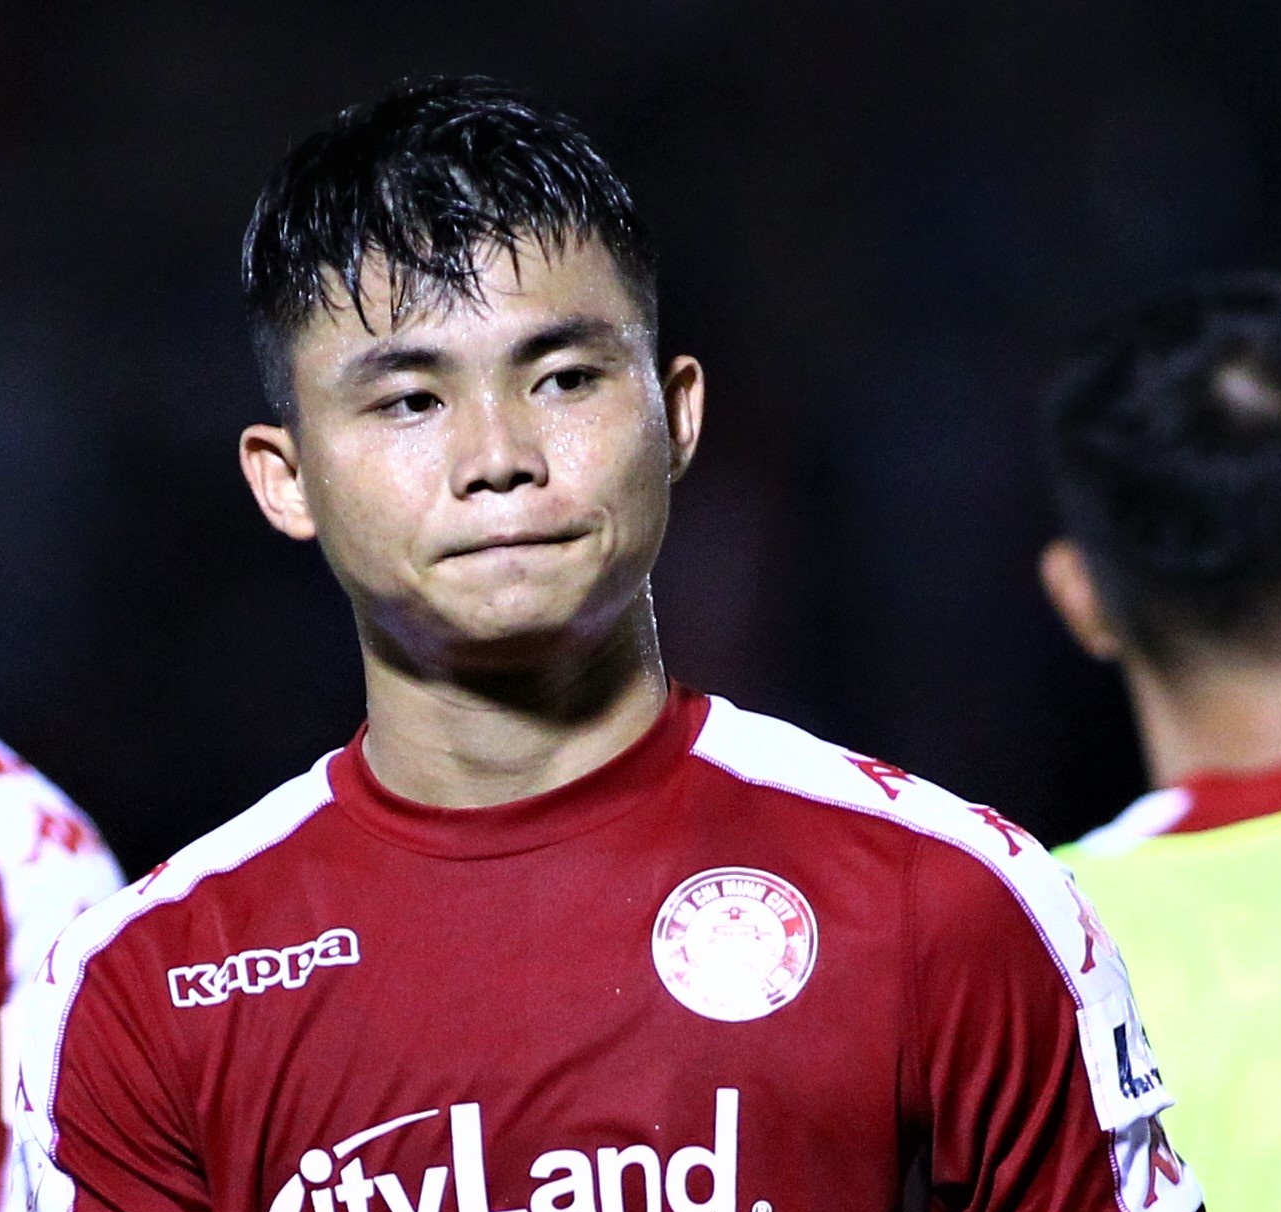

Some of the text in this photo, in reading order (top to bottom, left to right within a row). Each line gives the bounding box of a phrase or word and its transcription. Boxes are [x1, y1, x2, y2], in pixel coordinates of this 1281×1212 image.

[722, 879, 767, 900] MINH
[764, 891, 797, 921] CITY
[168, 928, 361, 1008] Kappa
